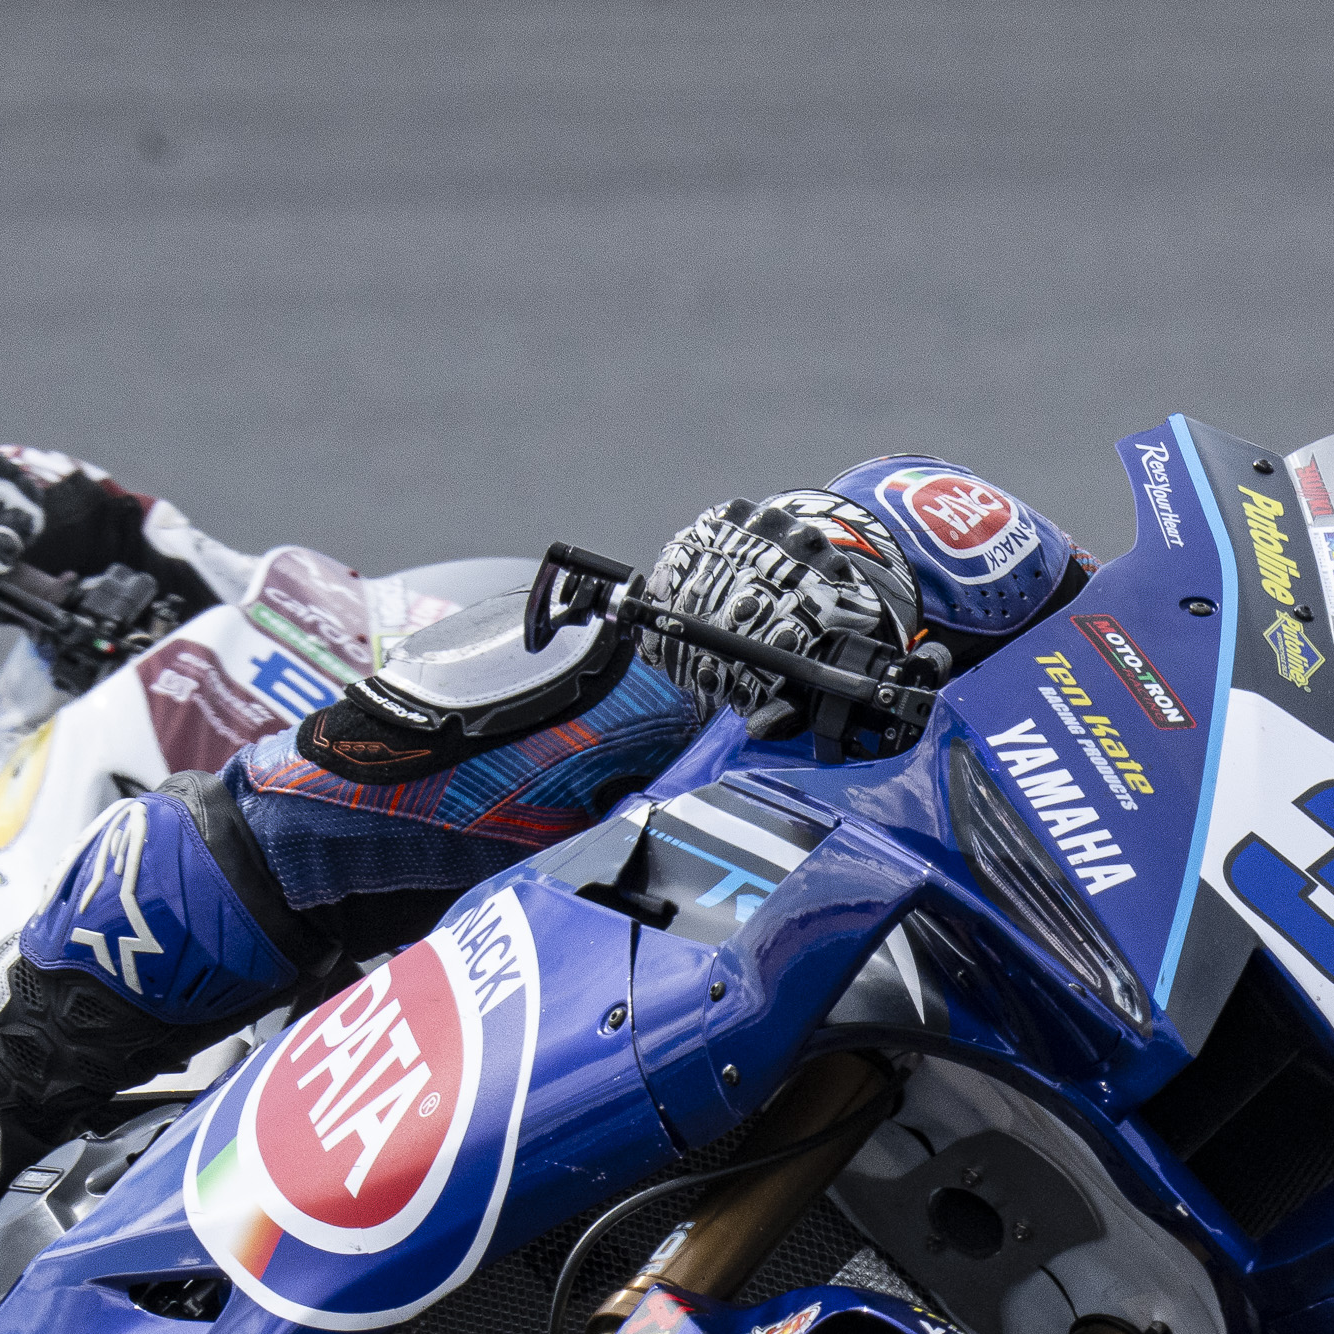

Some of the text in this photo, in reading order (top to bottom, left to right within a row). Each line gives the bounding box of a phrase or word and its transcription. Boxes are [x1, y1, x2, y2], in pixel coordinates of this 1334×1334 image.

[922, 482, 1004, 535] PATA
[1237, 485, 1301, 606] Putoline
[1092, 619, 1185, 724] MOTO-TRON
[1121, 667, 1166, 723] RACING
[1278, 613, 1307, 687] Putoline
[1033, 652, 1155, 795] Ten Kate
[1038, 686, 1139, 811] RACING PRODUCTS
[985, 718, 1137, 896] YAMAHA
[452, 902, 521, 1012] NACK
[290, 963, 432, 1198] PATA
